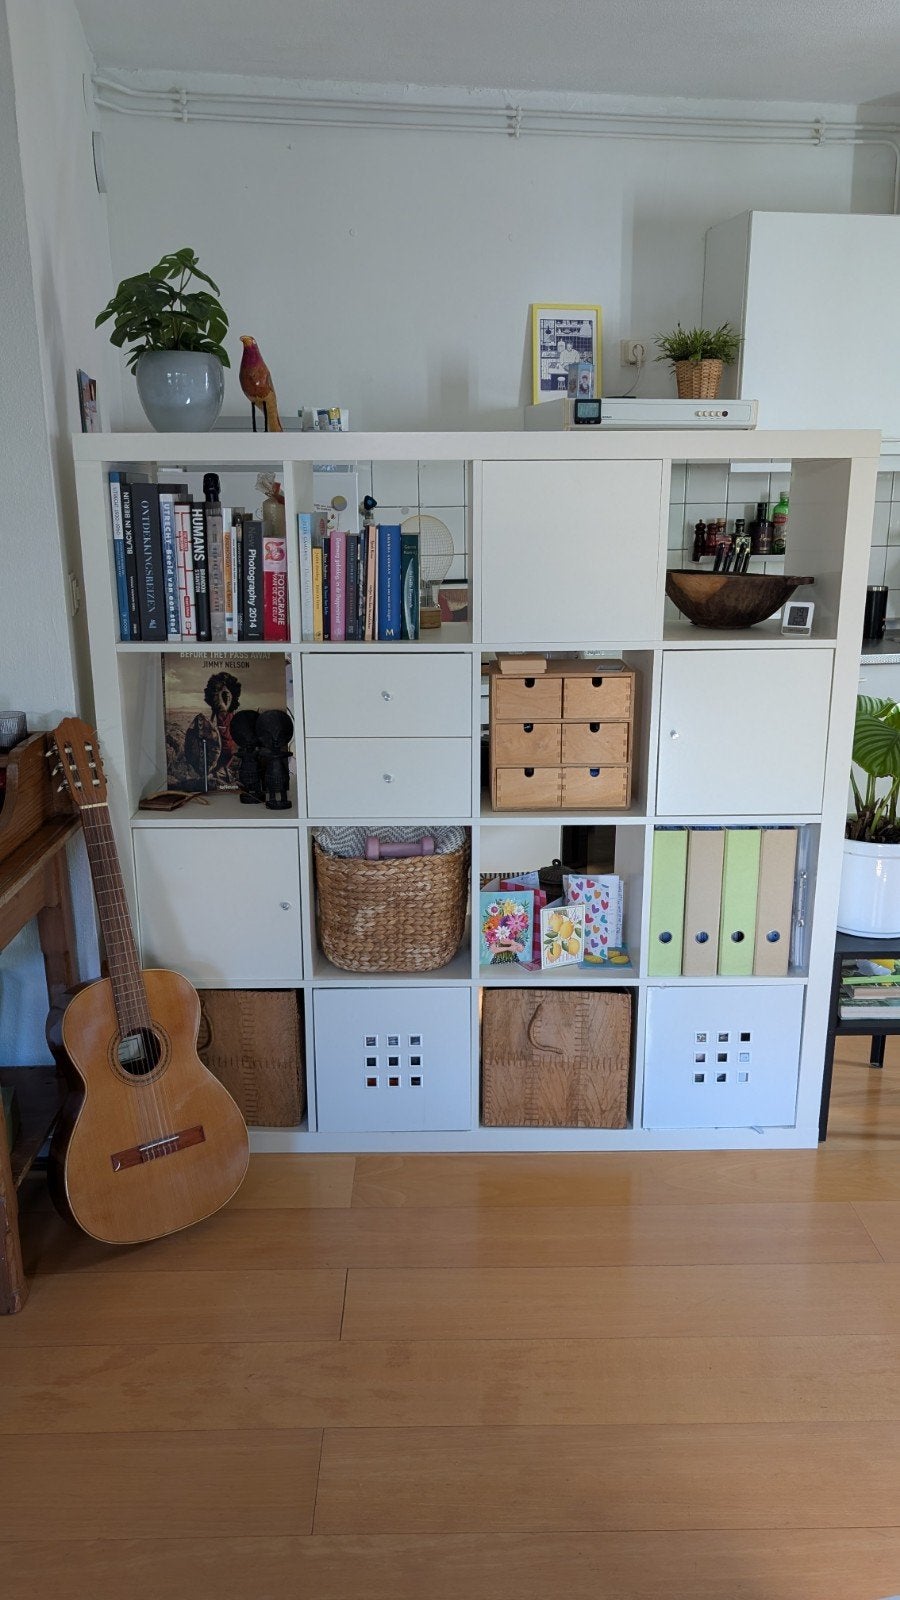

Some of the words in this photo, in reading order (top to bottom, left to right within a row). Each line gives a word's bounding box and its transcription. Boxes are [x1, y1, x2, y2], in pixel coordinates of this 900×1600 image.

[125, 520, 131, 528] IN
[164, 503, 172, 544] UTRECHT
[192, 508, 205, 562] HUMANS
[140, 500, 156, 613] ONTDEKKINGSREIZEN
[166, 548, 174, 574] Beeld
[246, 549, 257, 606] Photography
[249, 607, 257, 628] 2014
[277, 574, 285, 626] FOTOGRAFIE
